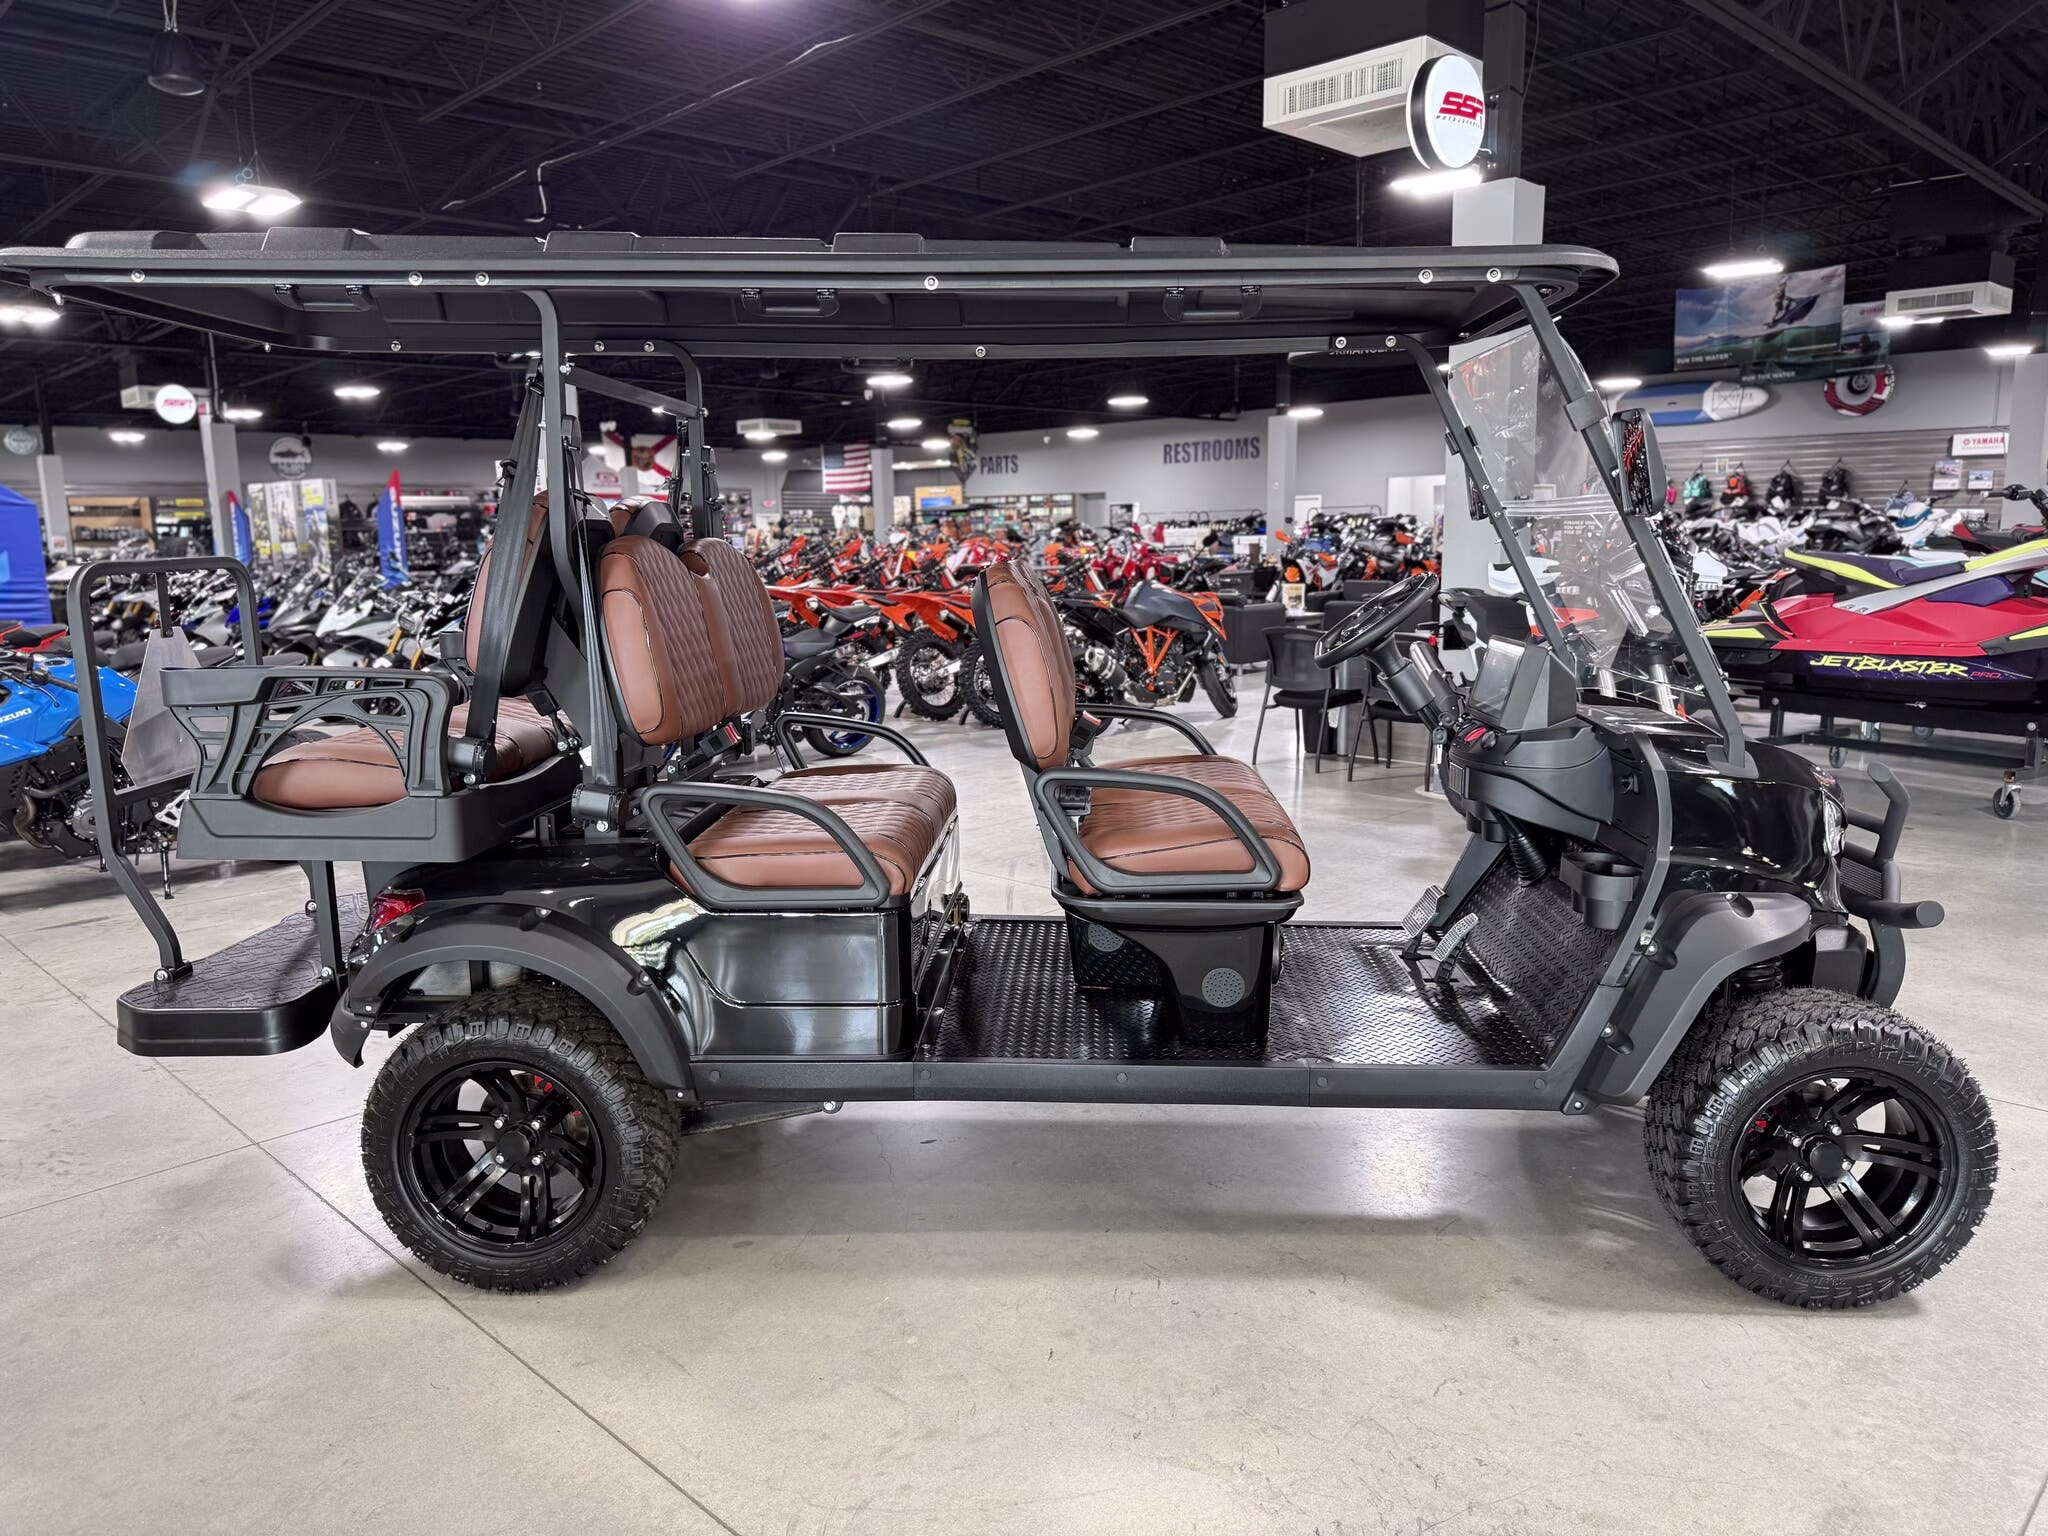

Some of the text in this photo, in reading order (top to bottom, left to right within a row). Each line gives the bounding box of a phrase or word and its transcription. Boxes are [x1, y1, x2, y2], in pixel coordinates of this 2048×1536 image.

[1163, 437, 1260, 465] RESTROOMS
[1972, 437, 2005, 445] YAMAHA
[980, 454, 1019, 475] PARTS
[1809, 655, 1969, 677] JETBLASTER
[1970, 671, 2000, 679] PRO
